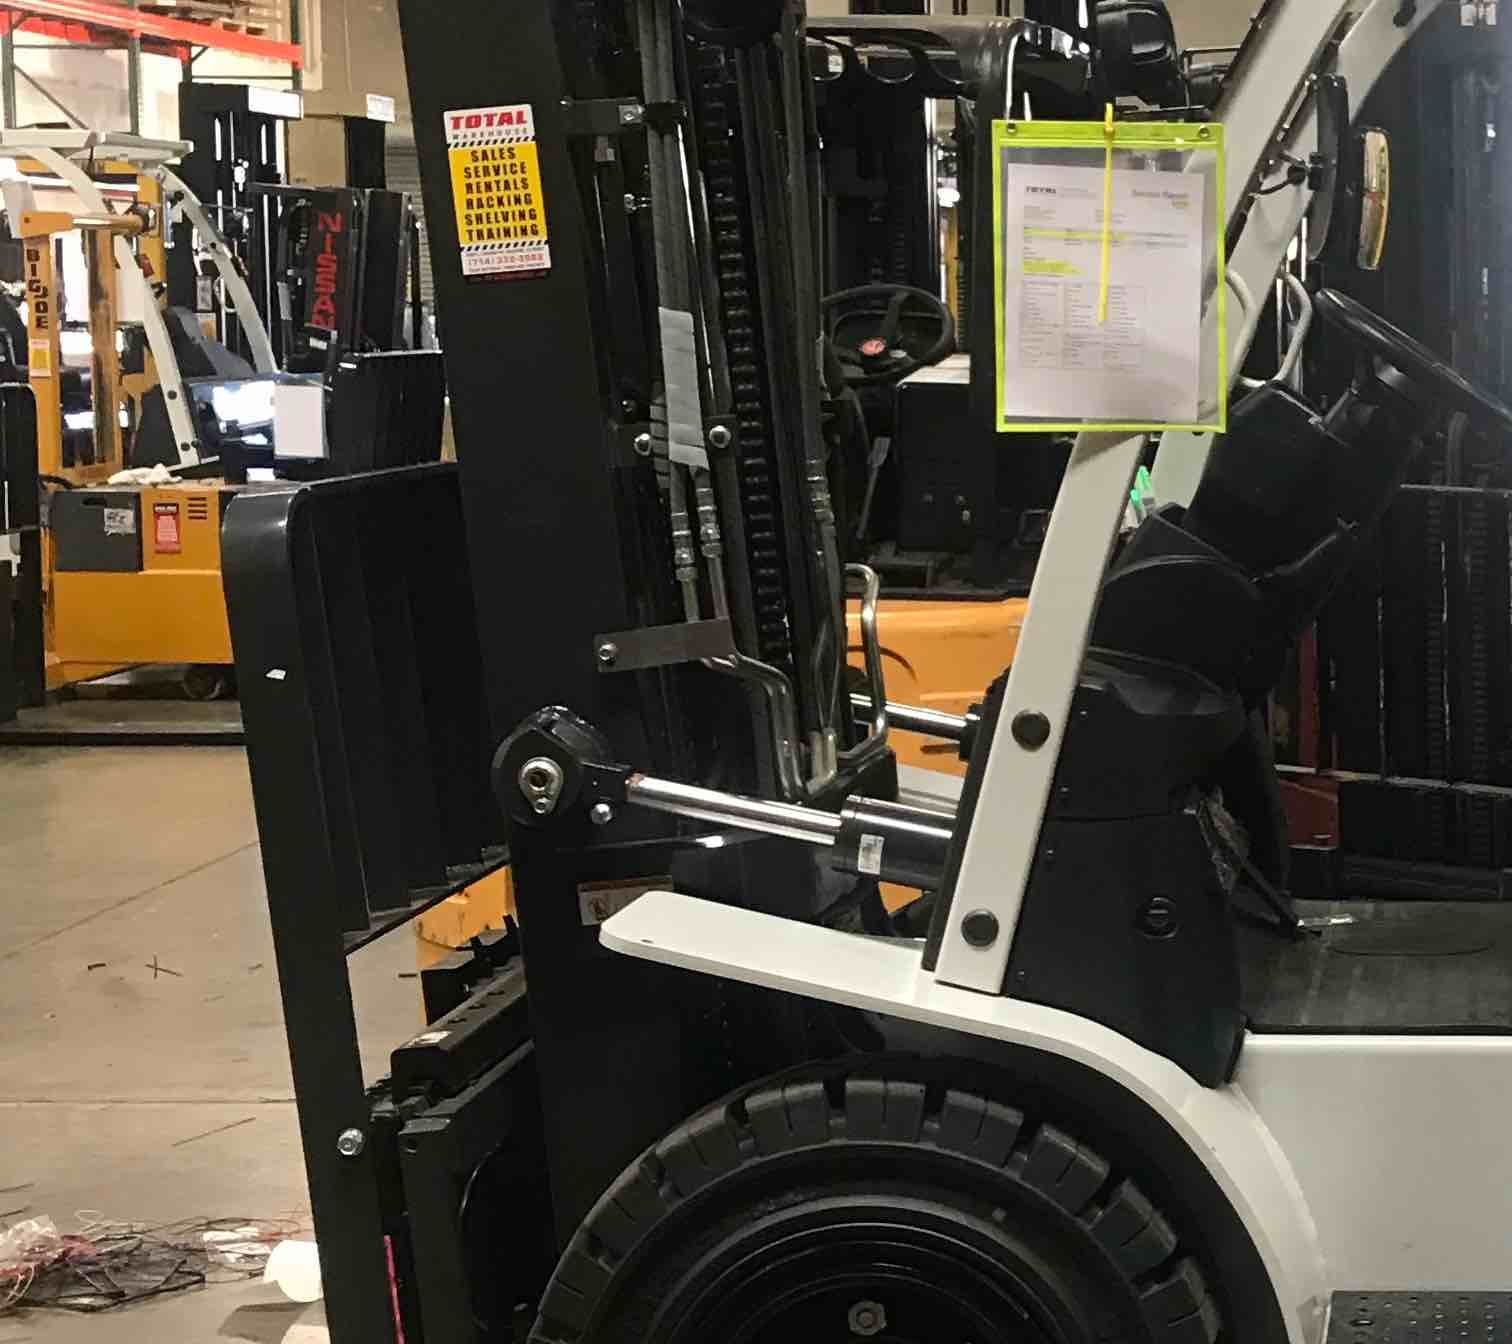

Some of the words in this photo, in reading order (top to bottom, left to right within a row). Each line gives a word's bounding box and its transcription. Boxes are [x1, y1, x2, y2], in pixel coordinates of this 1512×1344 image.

[450, 111, 528, 130] TOTAL
[452, 129, 528, 141] WAREHOUSE
[470, 147, 517, 163] SALES
[464, 162, 527, 179] SERVICE
[465, 177, 529, 194] RENTALS
[466, 193, 533, 210] RACKING
[465, 208, 537, 226] SHELVING
[466, 224, 539, 242] TRAINING
